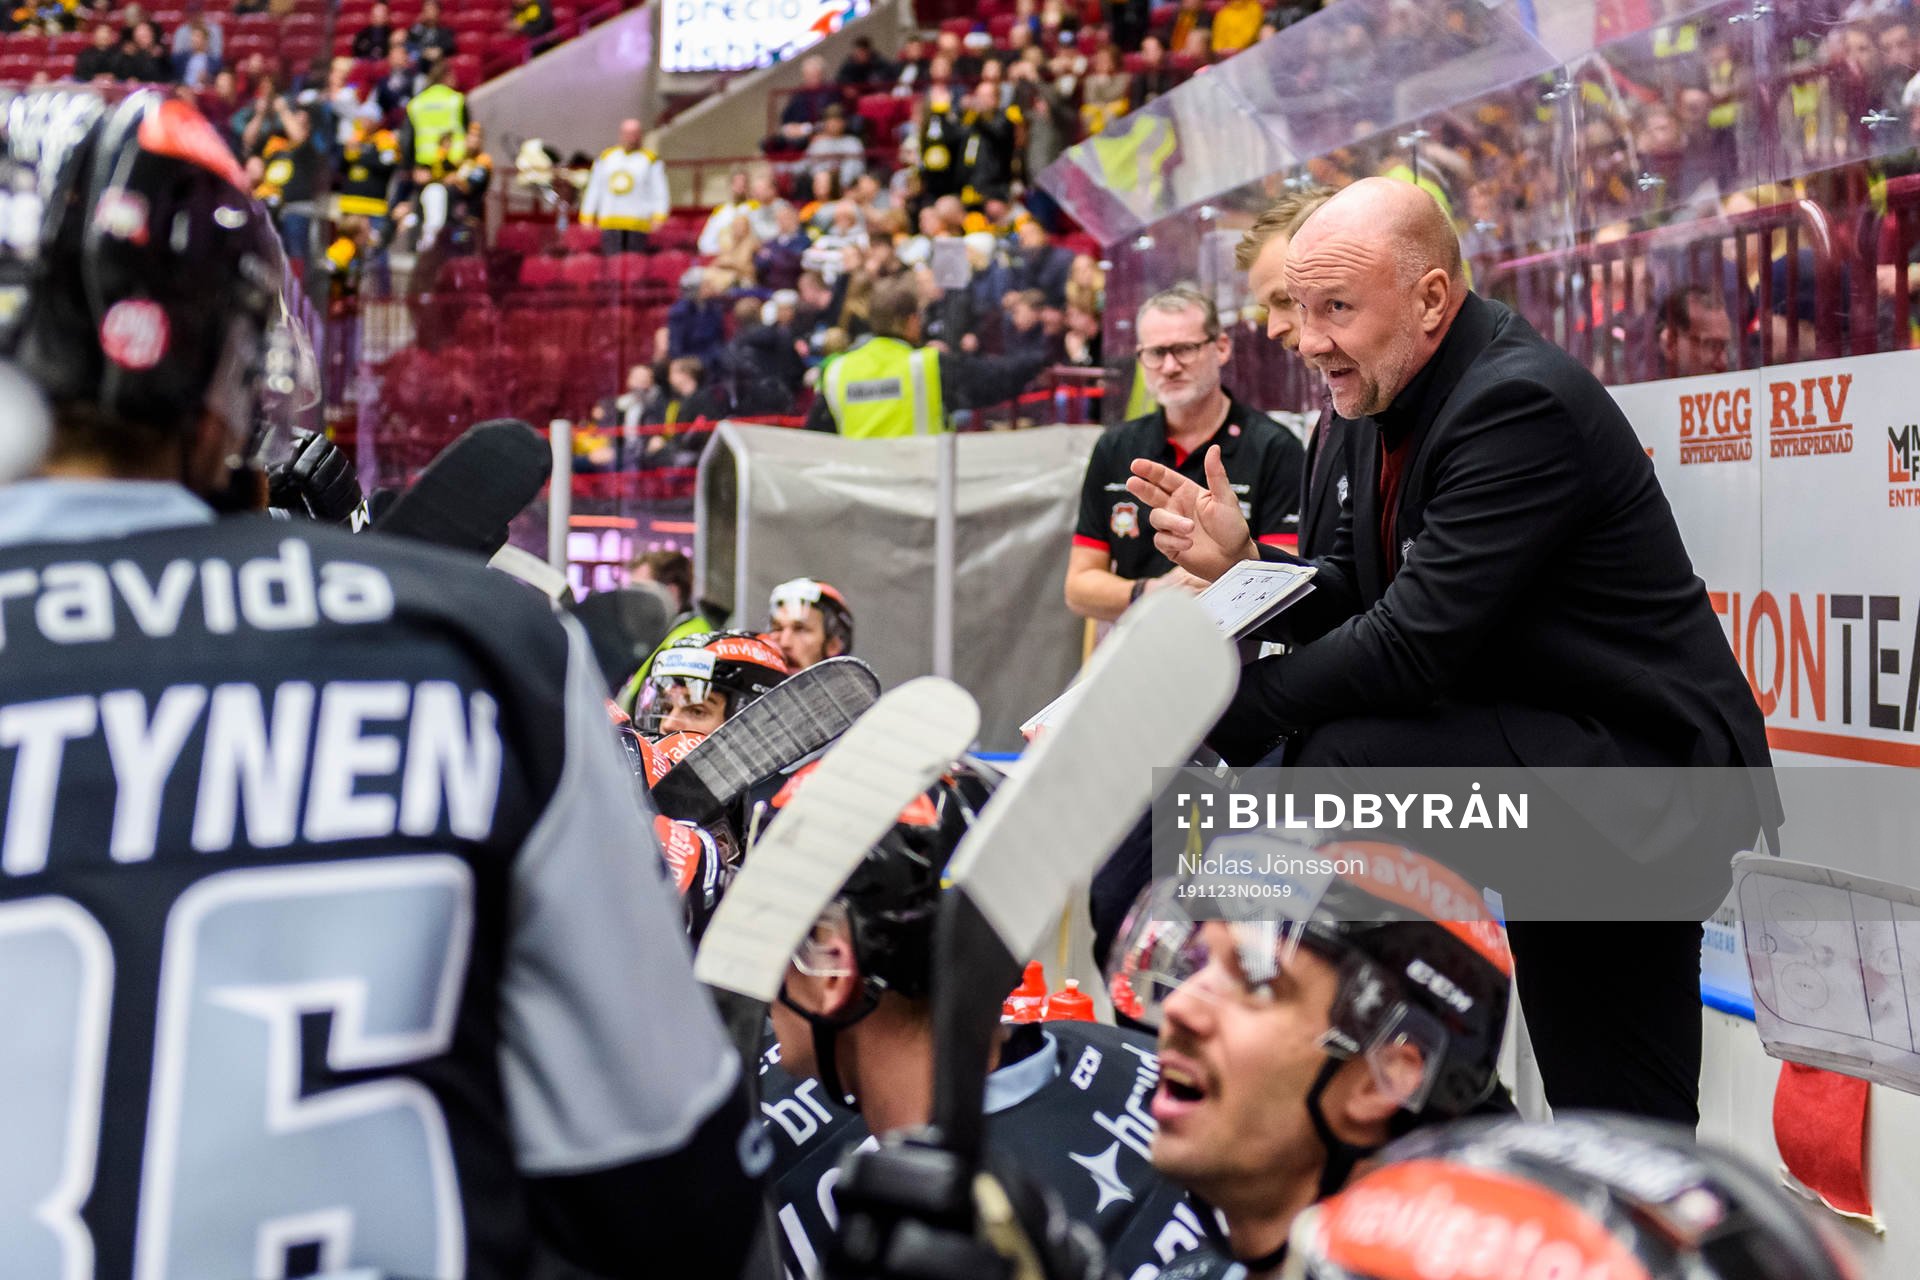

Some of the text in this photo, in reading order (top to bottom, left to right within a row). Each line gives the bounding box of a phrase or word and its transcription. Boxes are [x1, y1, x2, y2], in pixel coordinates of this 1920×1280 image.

[1679, 388, 1752, 436] BYGG
[1769, 373, 1852, 427] RIV
[1680, 441, 1752, 465] ENTREPRENAD
[1770, 432, 1853, 458] ENTREPRENAD
[0, 680, 502, 876] TYNEN
